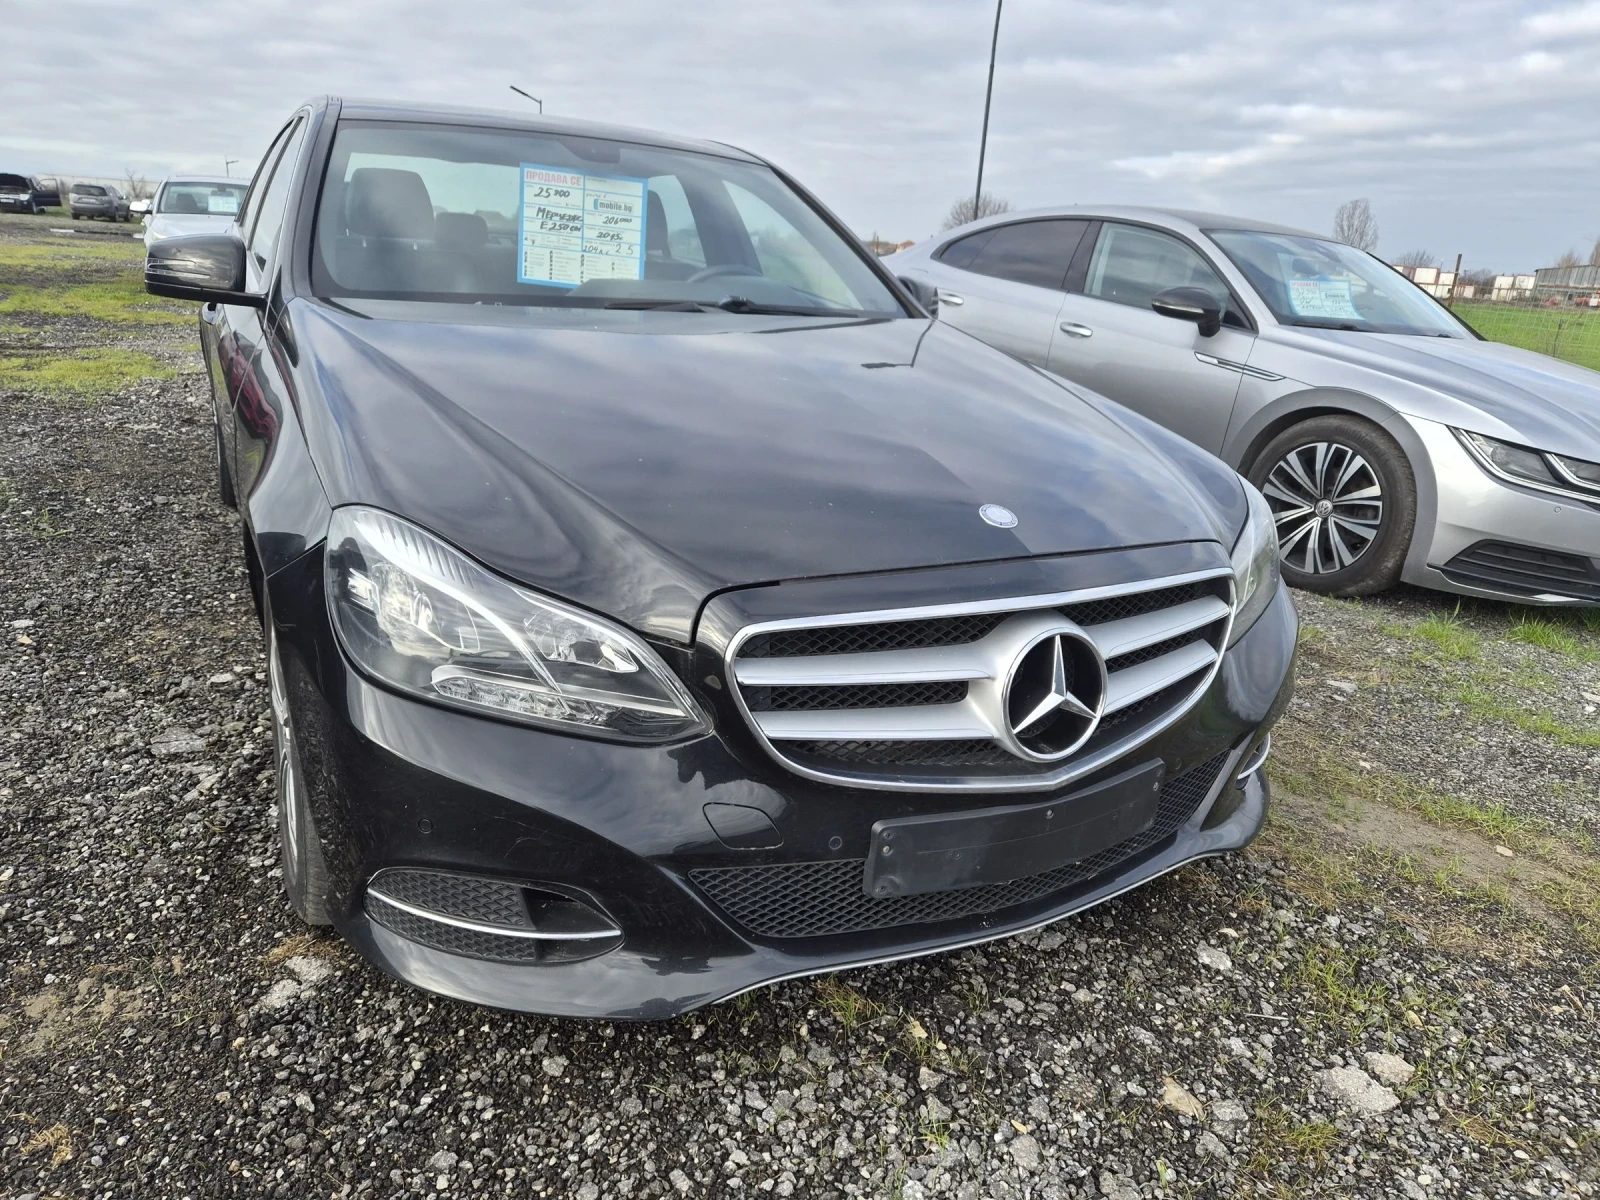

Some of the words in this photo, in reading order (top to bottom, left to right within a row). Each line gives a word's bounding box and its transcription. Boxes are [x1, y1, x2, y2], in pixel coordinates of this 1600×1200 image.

[526, 170, 568, 184] ПРОДАВА
[570, 176, 582, 186] СЕ
[599, 201, 633, 214] mobile.bg
